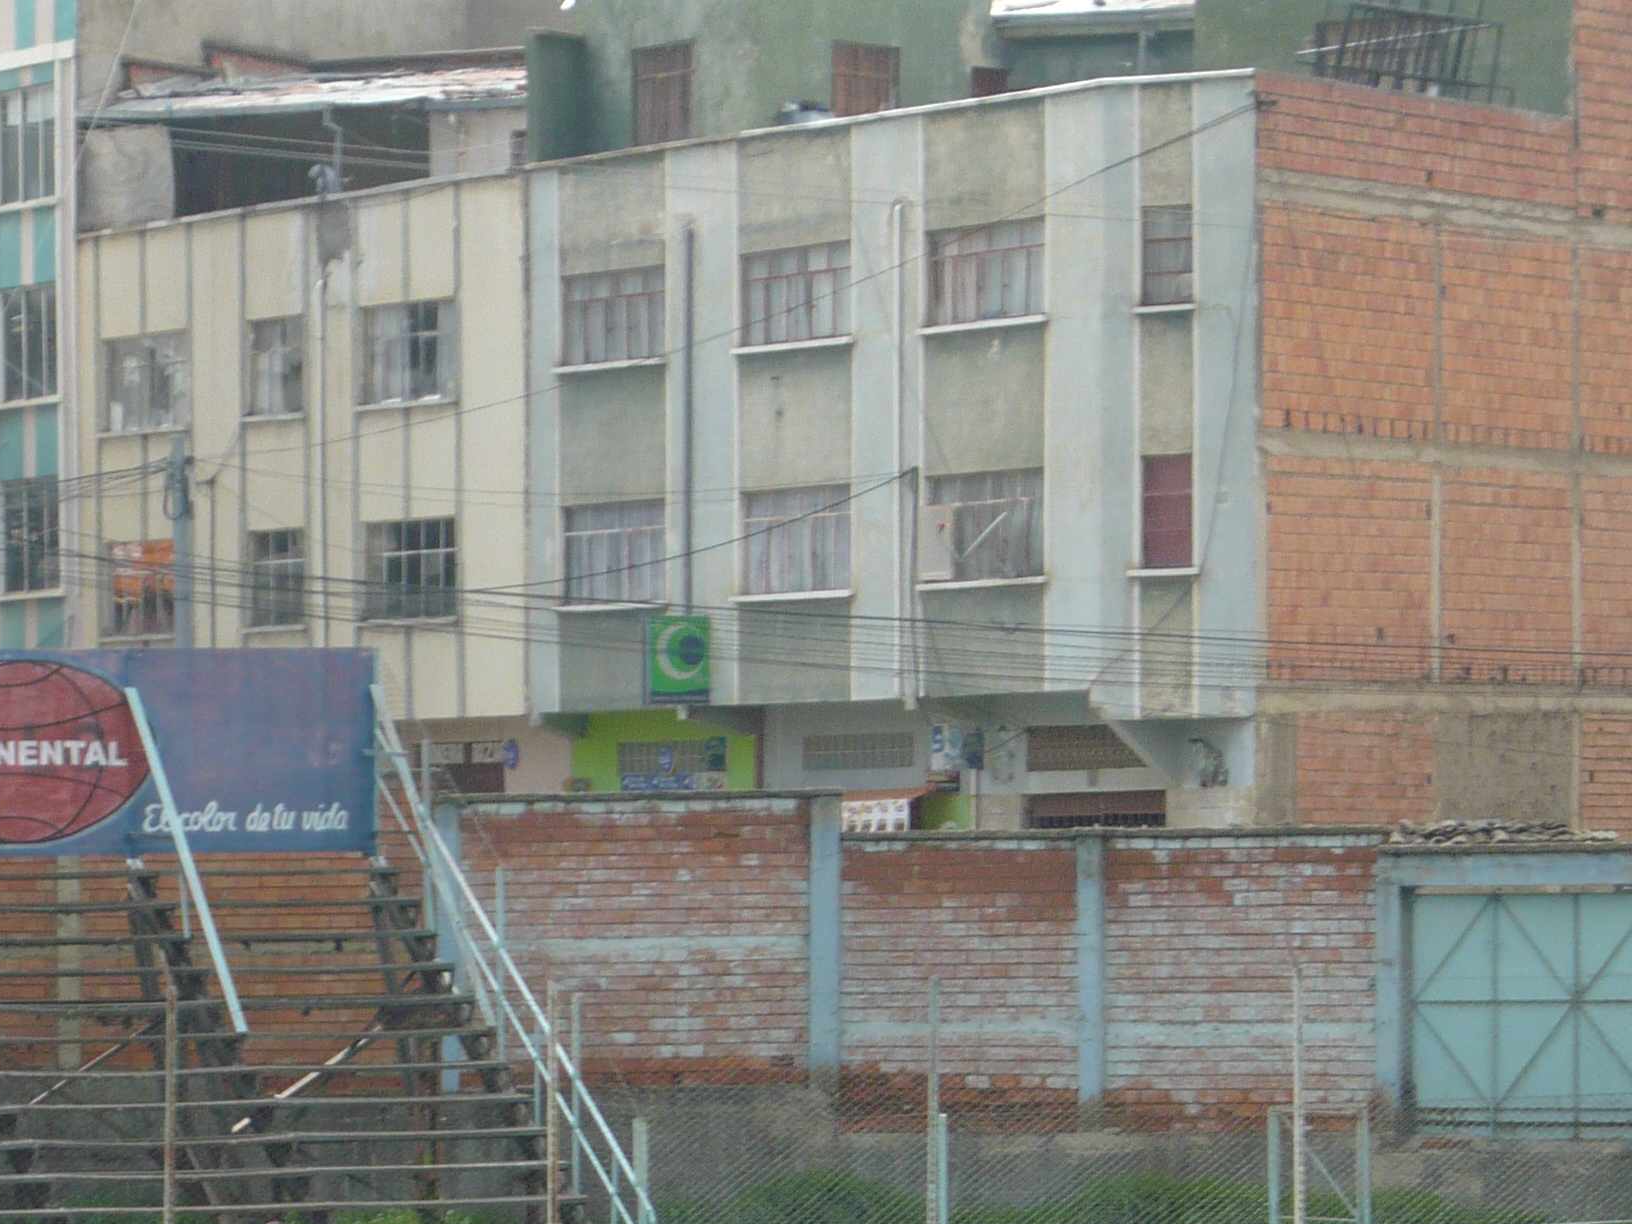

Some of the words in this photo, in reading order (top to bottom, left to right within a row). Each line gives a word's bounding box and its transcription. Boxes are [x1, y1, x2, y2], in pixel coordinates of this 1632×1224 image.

[179, 800, 238, 833] color
[245, 802, 270, 832] de
[272, 801, 296, 831] tu
[301, 801, 349, 832] vida
